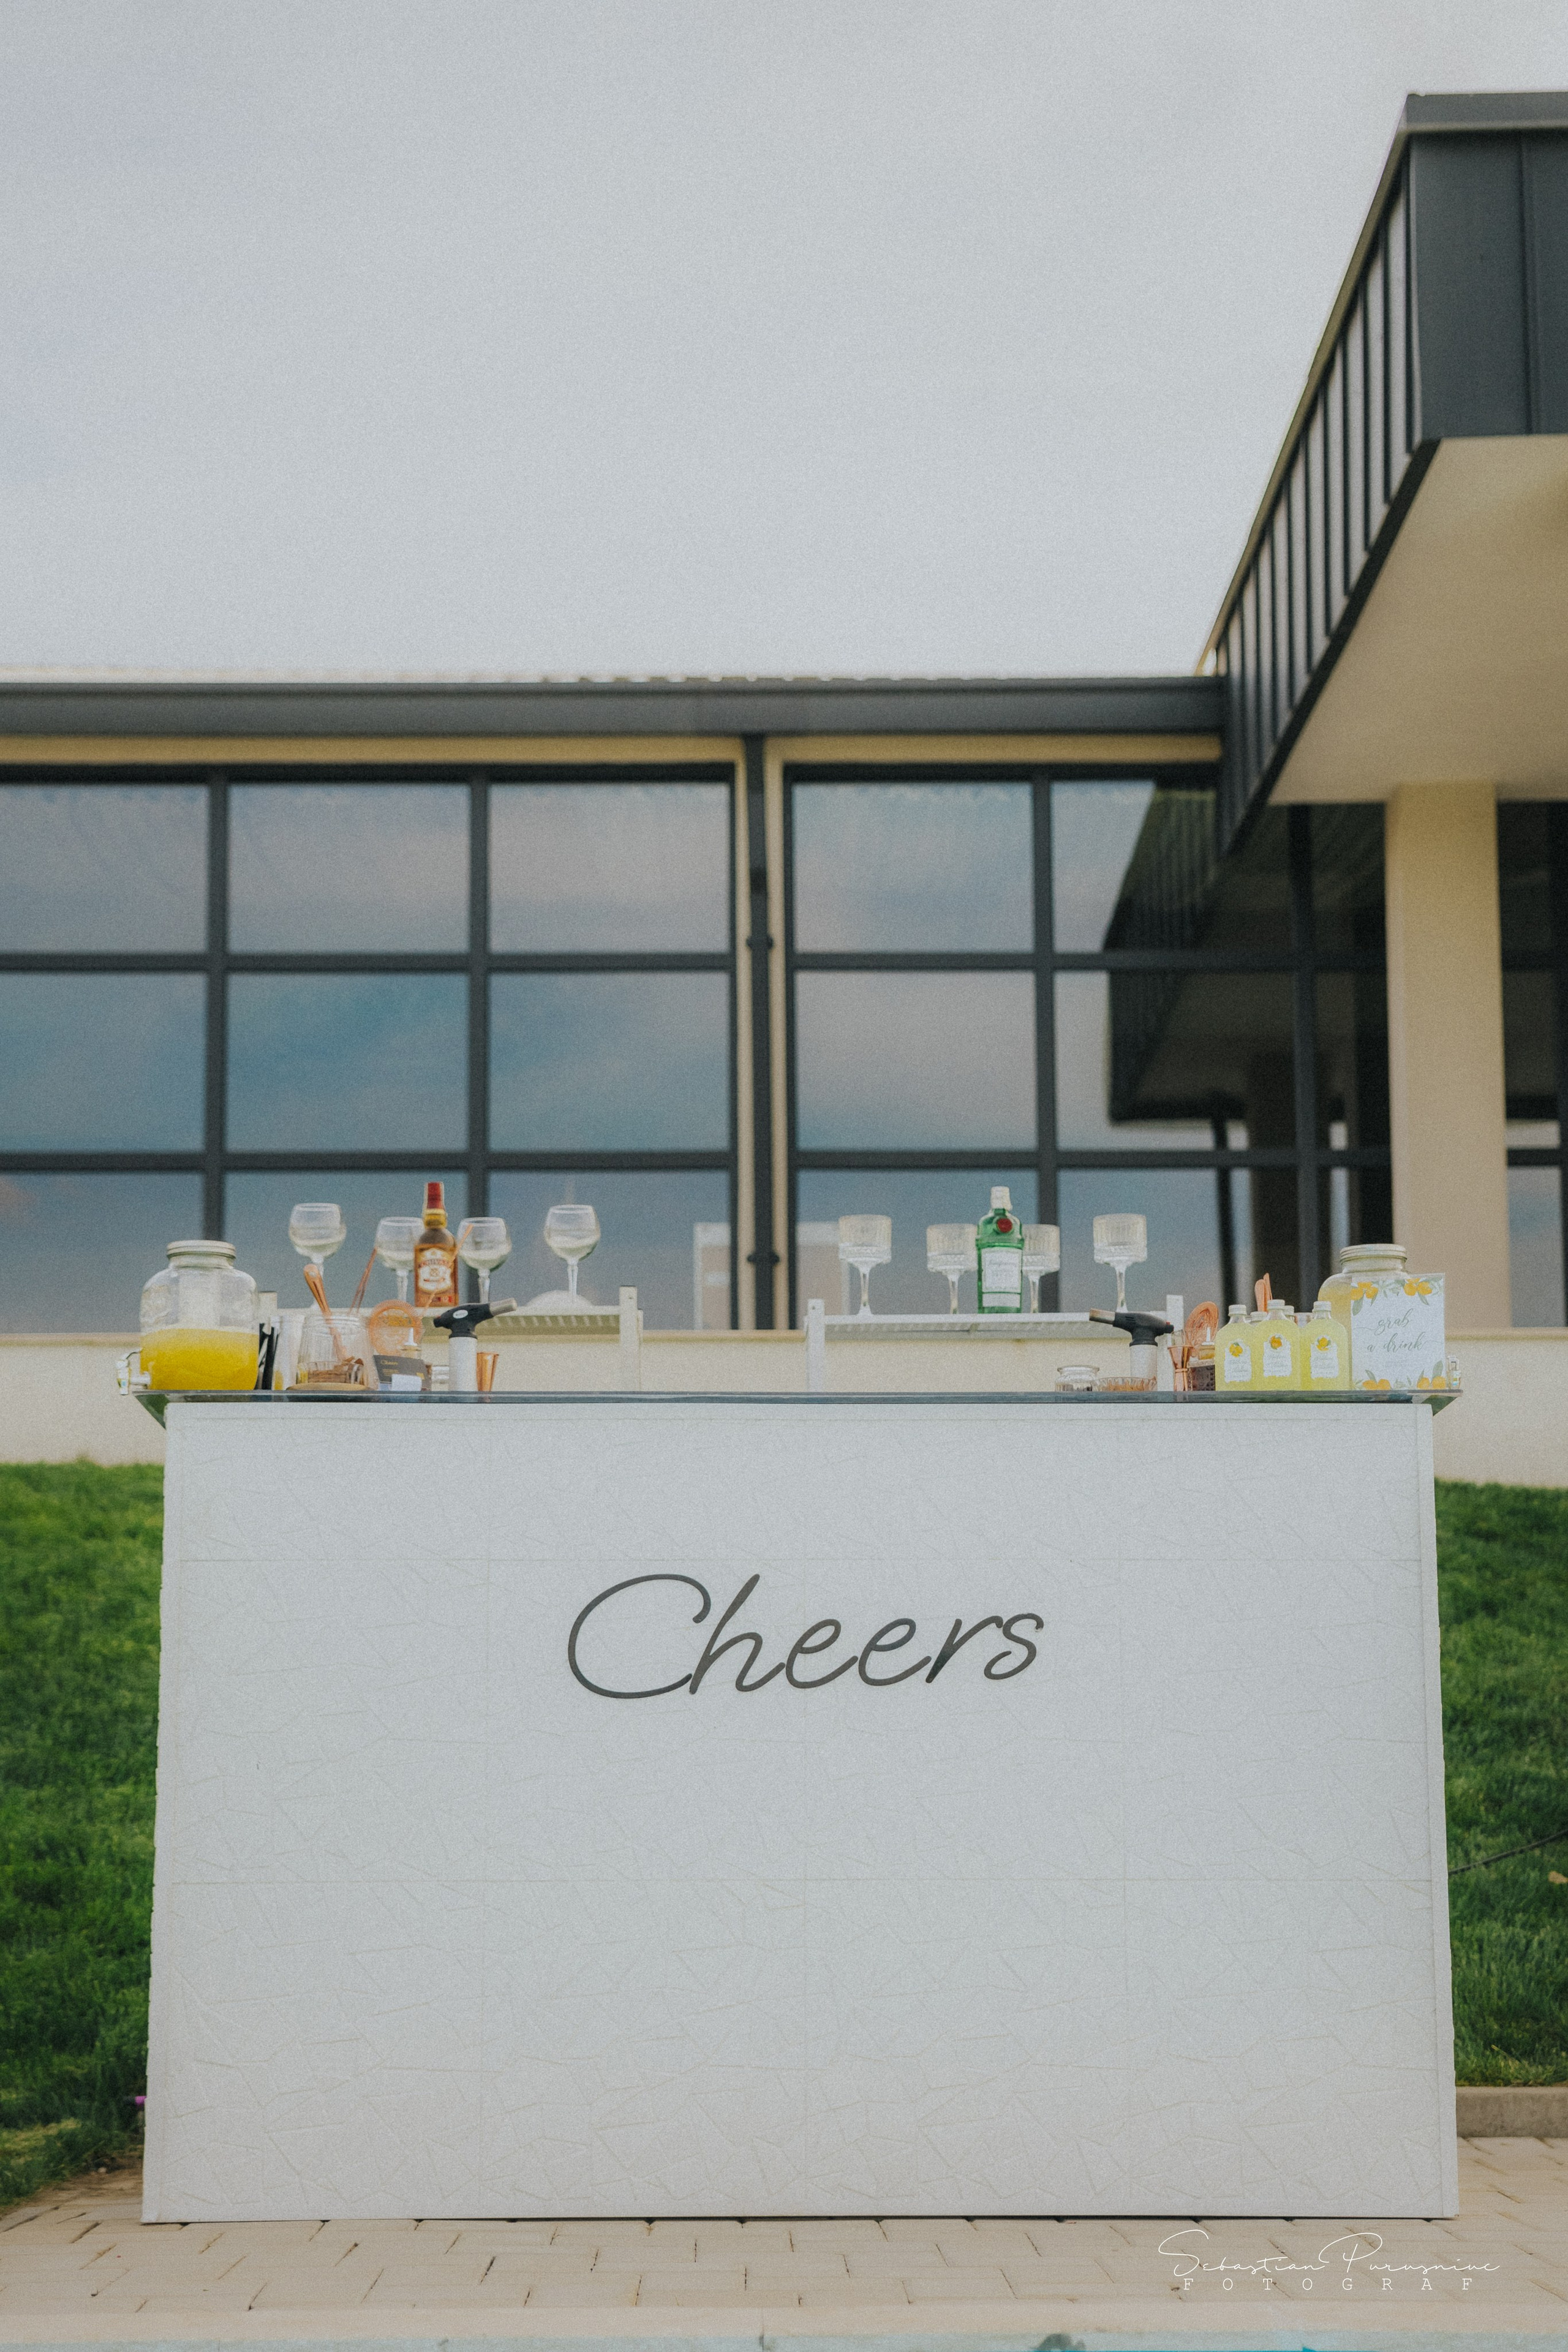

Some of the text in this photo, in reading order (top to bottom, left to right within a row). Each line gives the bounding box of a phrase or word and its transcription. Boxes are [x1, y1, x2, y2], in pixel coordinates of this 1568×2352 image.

[1353, 1308, 1414, 1336] grab
[1367, 1332, 1443, 1352] a drink
[568, 1574, 1044, 1699] Cheers
